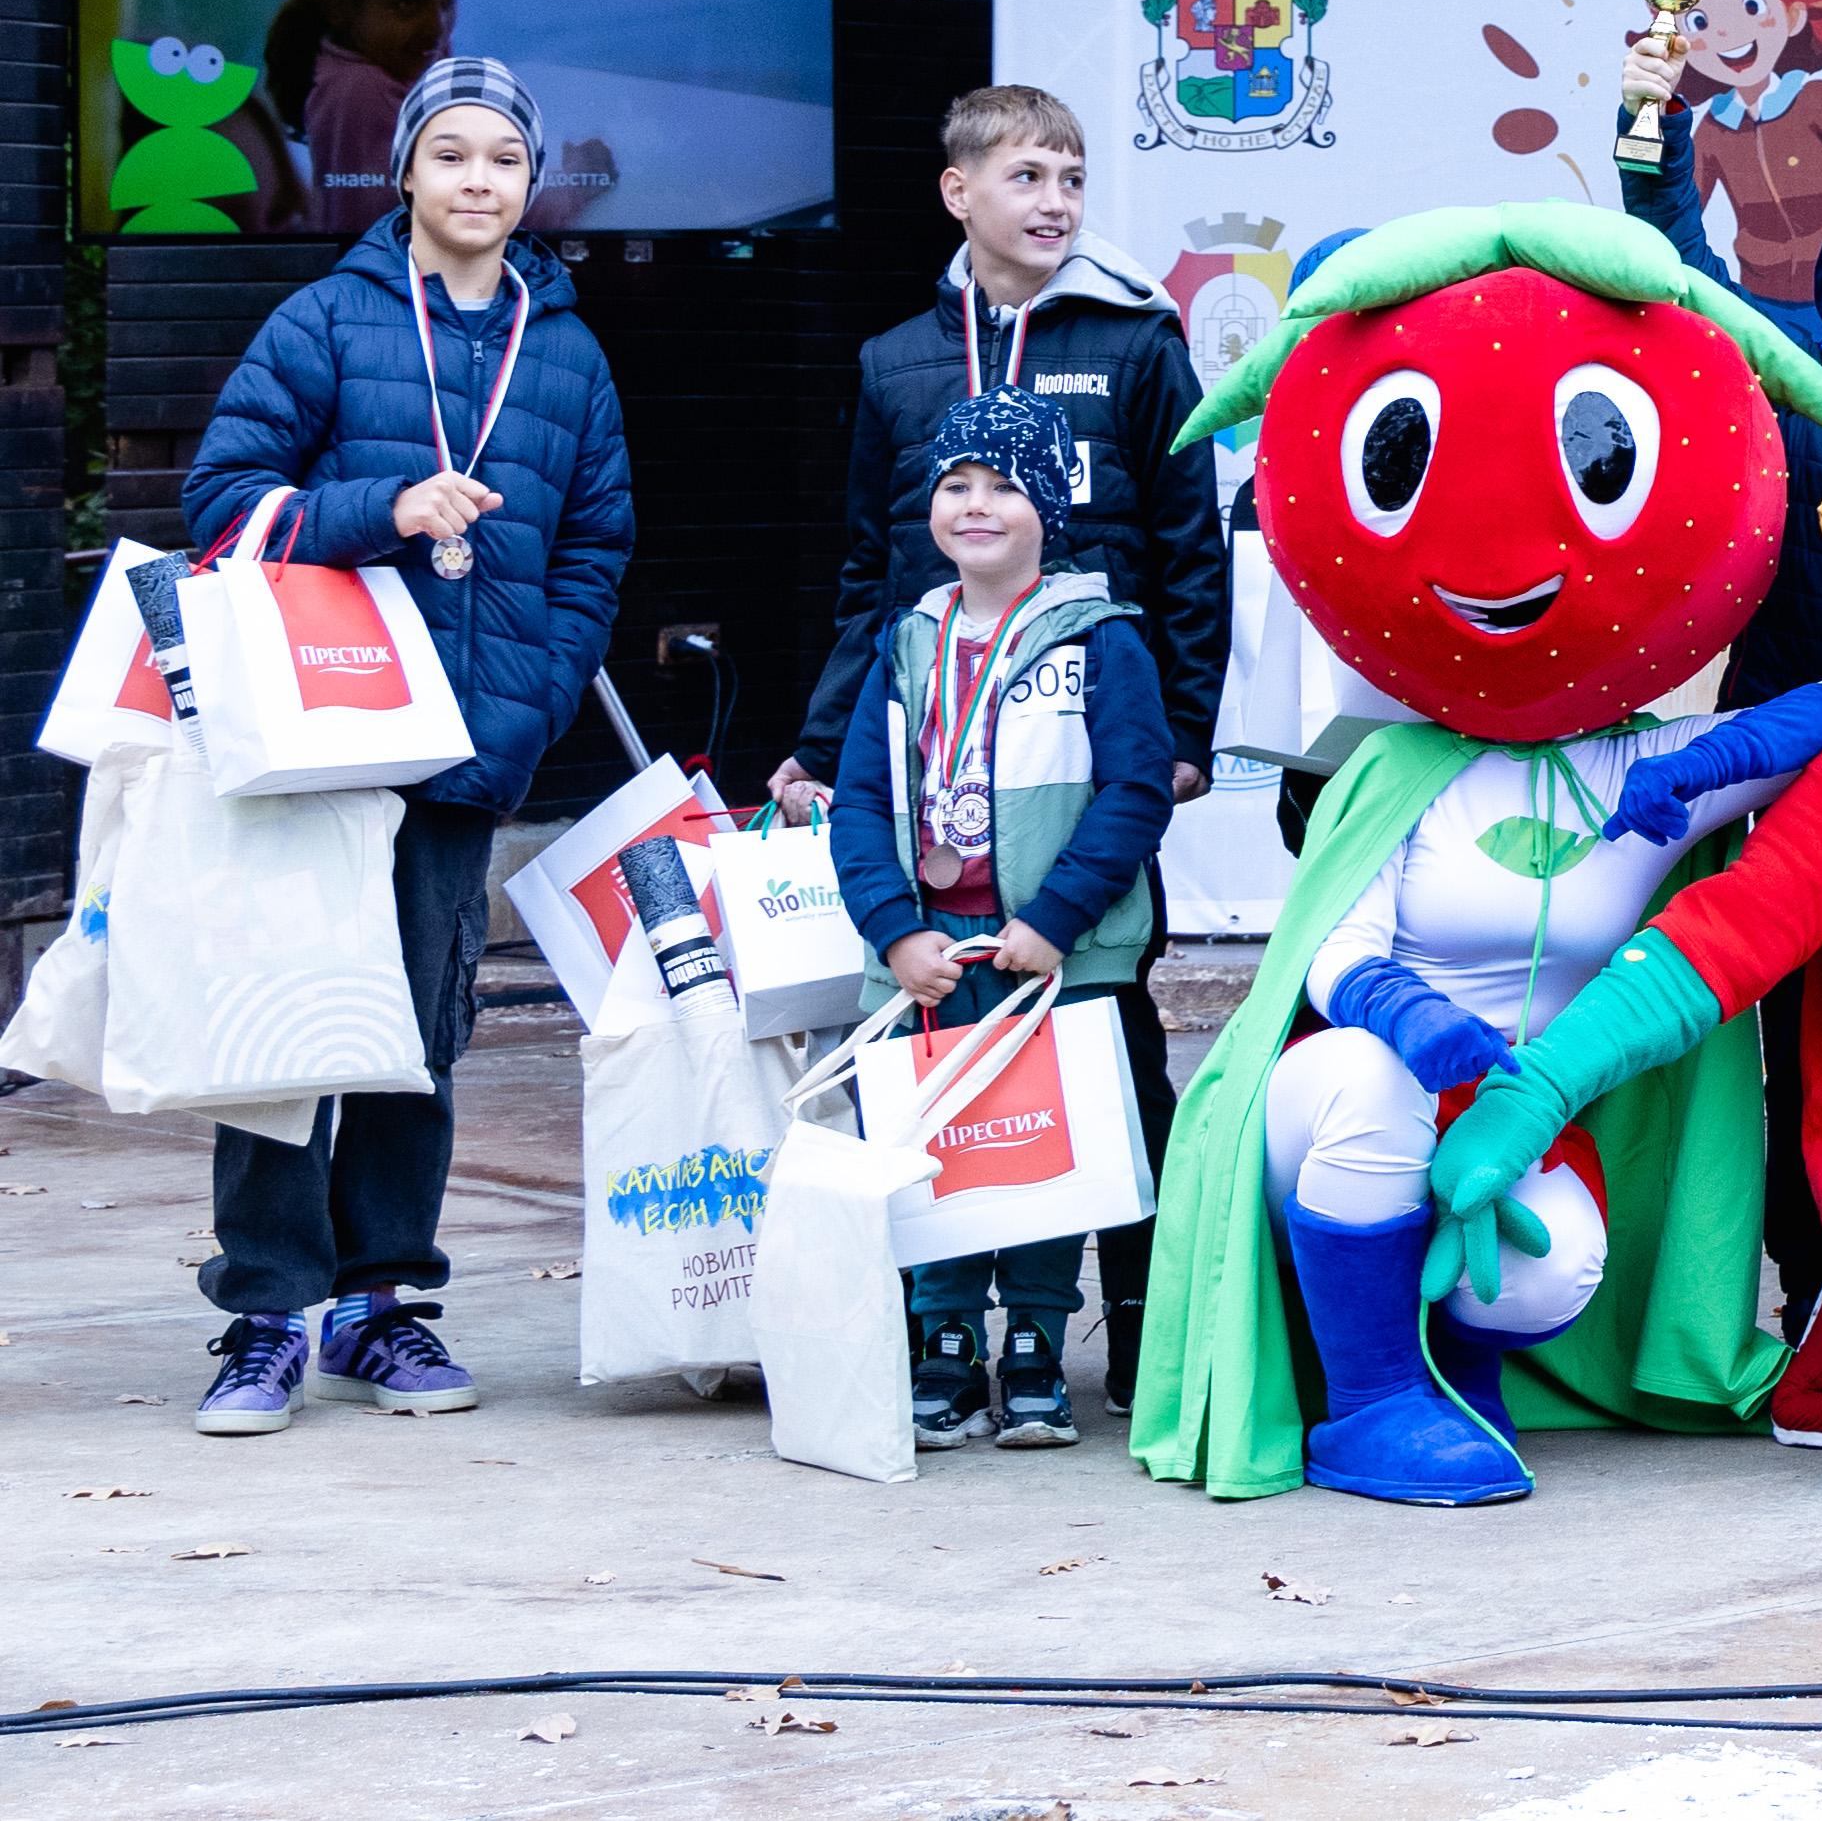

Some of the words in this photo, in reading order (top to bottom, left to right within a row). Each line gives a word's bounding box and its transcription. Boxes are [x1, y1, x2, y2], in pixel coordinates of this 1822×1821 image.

[299, 644, 394, 668] ПРЕСТИЖ
[936, 1107, 1056, 1149] ПРЕСТИЖ
[606, 1150, 773, 1198] КАЛПАЗАНС
[643, 1197, 710, 1235] ЕСЕН
